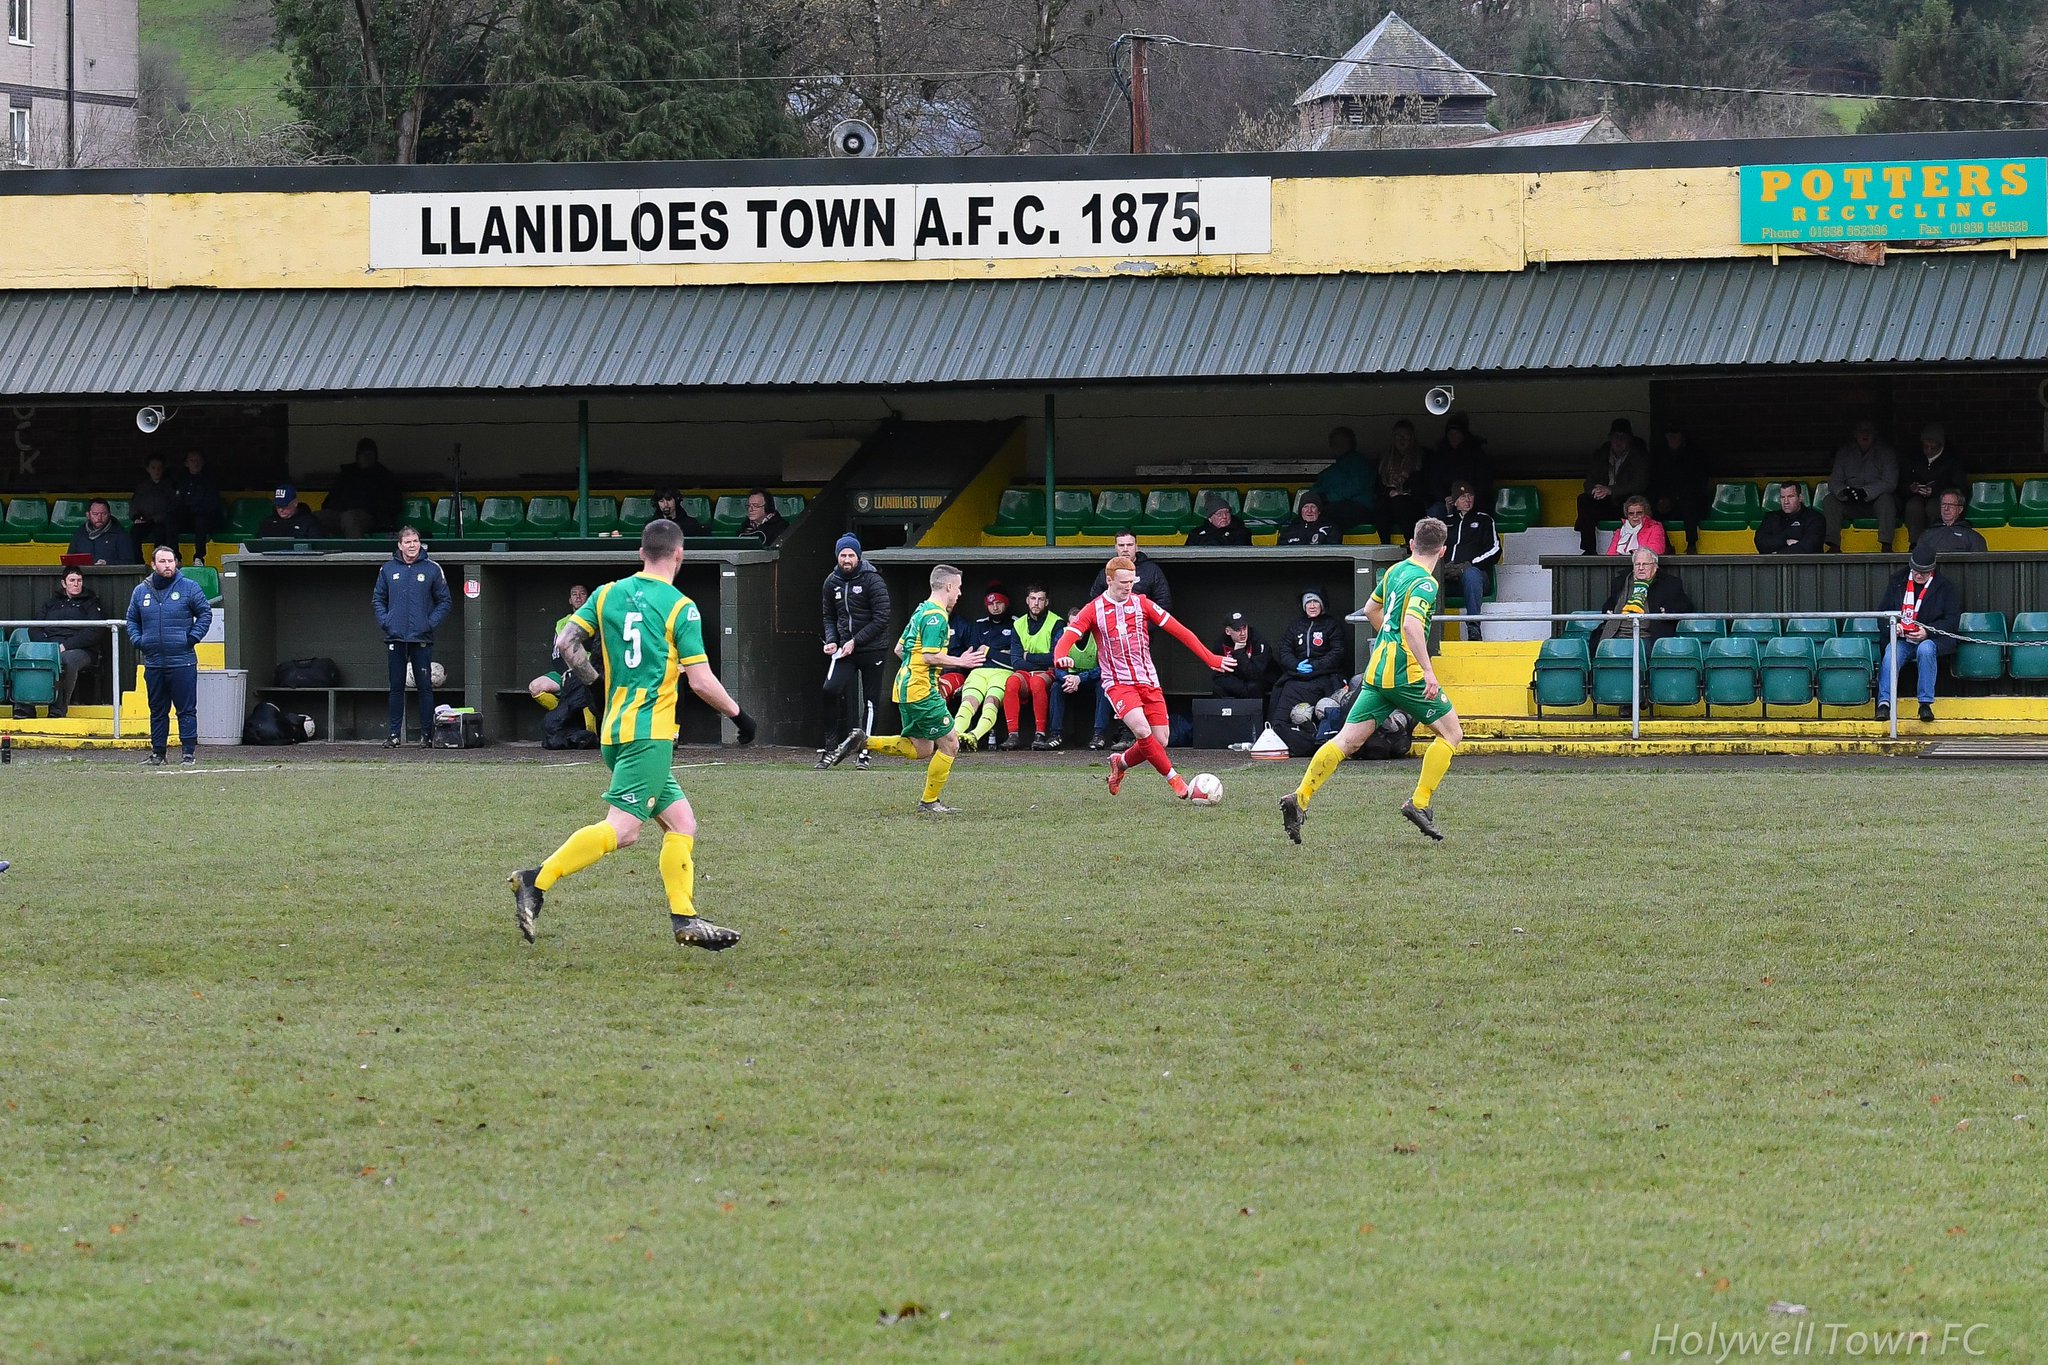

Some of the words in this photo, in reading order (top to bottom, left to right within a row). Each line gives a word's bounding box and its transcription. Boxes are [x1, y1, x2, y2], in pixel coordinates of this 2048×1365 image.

[1760, 163, 2028, 203] POTTERS
[420, 200, 729, 255] LLANIDLOES
[746, 198, 895, 249] TOWN
[916, 193, 1060, 247] A.F.C.
[1081, 191, 1216, 245] 1875.
[1792, 202, 1997, 222] RECYCLING
[873, 495, 918, 509] LLANIDLOES
[623, 611, 643, 669] 5
